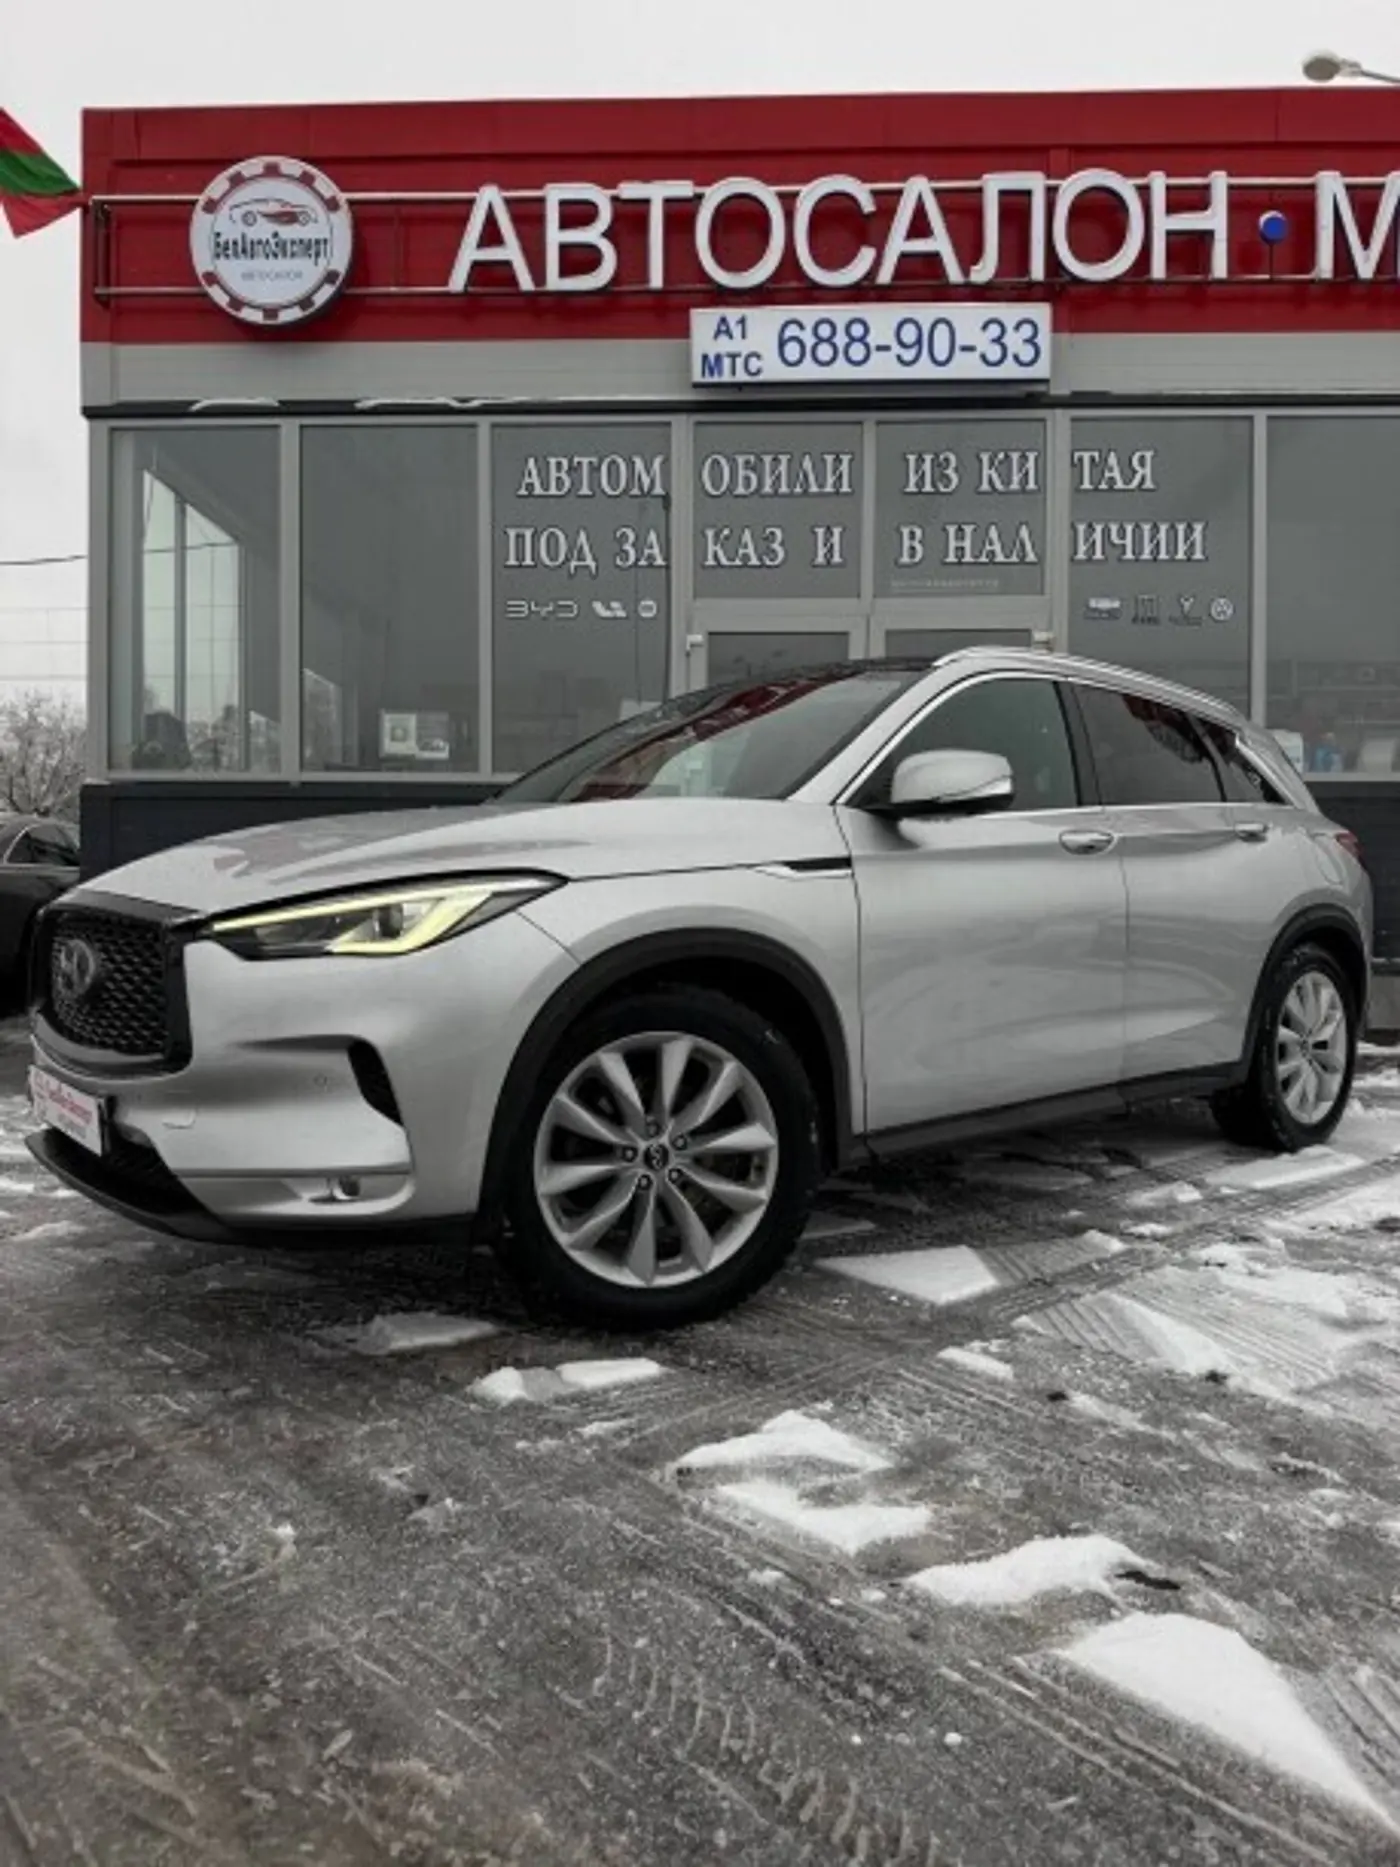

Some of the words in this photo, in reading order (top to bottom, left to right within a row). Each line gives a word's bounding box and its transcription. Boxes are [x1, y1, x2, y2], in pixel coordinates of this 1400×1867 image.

[449, 169, 1228, 291] АВТОСАЛОН
[713, 315, 748, 341] A1
[777, 317, 1042, 367] 688-90-33
[701, 352, 763, 378] МТС
[904, 452, 959, 493] ИЗ
[503, 527, 599, 576] ПОД
[812, 526, 845, 566] И
[898, 524, 926, 565] В
